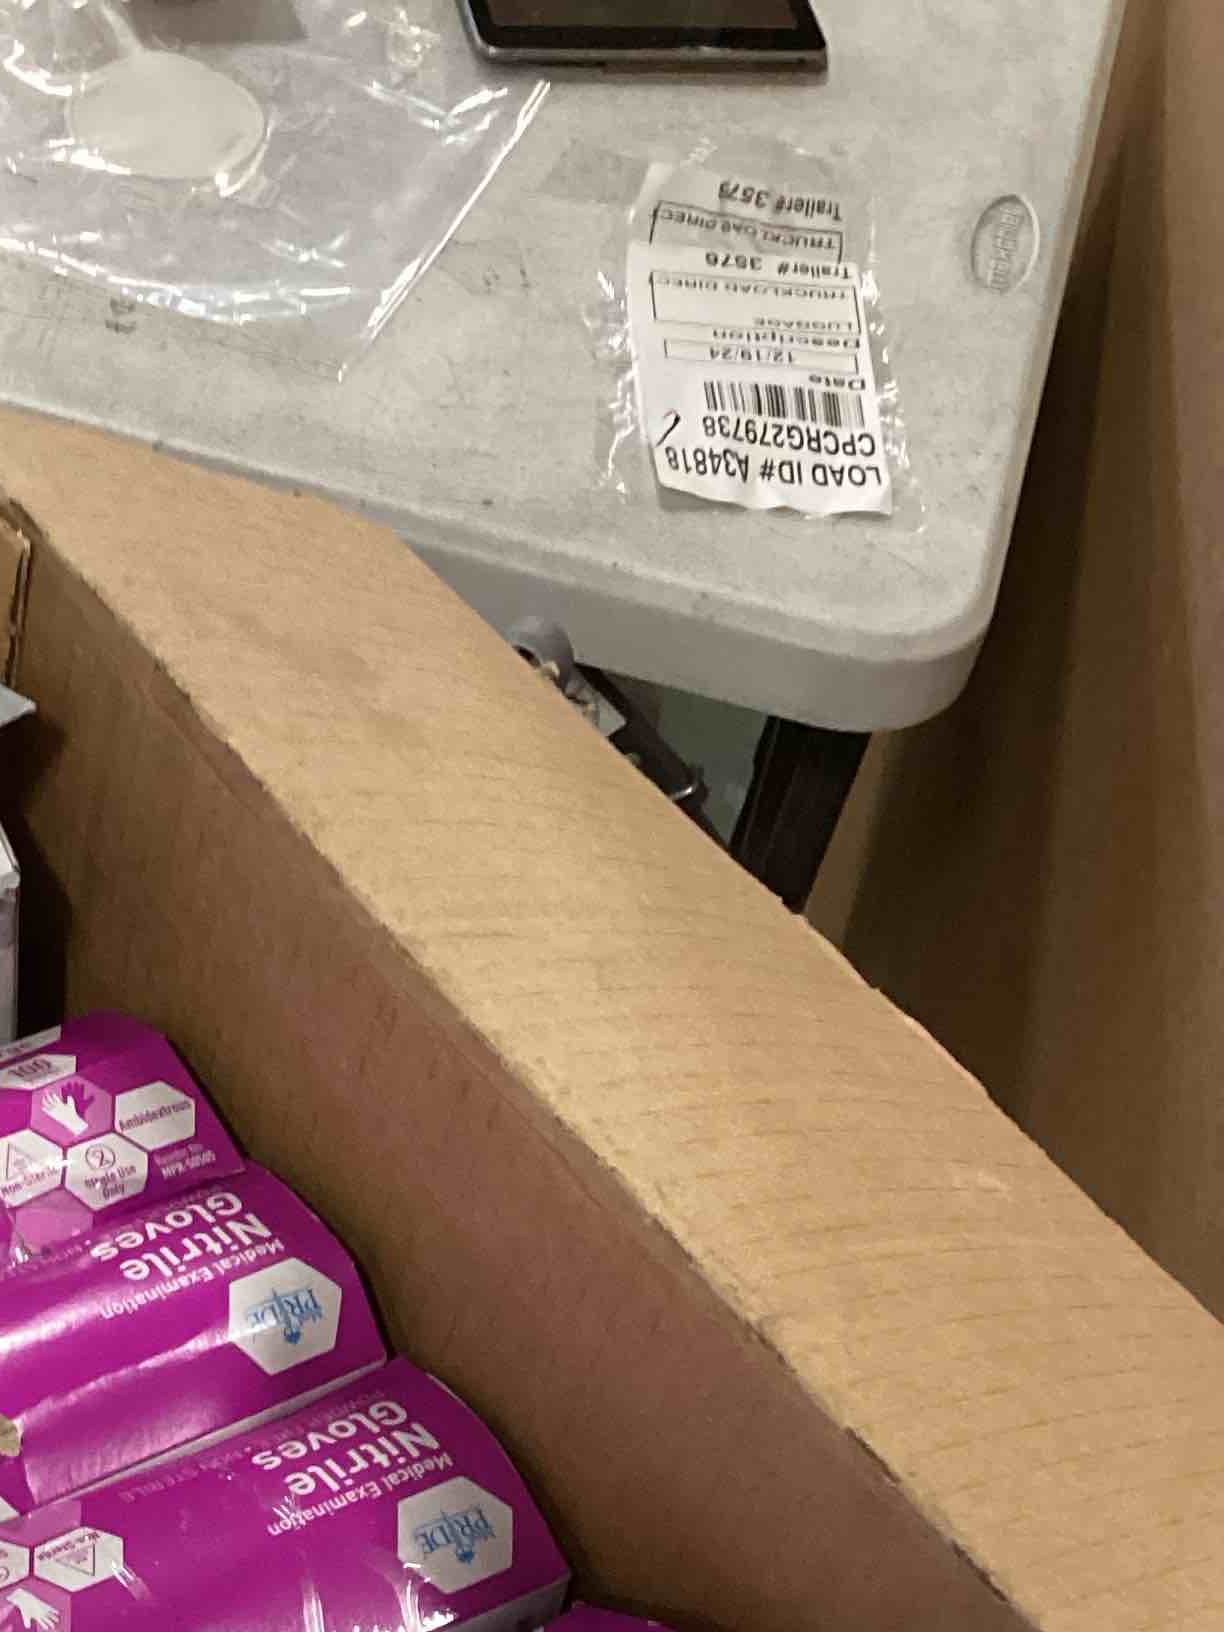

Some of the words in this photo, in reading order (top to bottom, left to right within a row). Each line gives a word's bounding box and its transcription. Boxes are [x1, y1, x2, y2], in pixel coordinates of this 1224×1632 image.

[712, 328, 861, 350] Description
[808, 375, 866, 391] Date
[703, 415, 876, 457] CPCRG279738
[760, 458, 803, 486] ID#
[811, 463, 881, 487] LOAD
[91, 1191, 243, 1262] Gloves
[119, 1213, 273, 1281] Nitrile
[219, 1237, 285, 1277] Medical
[100, 1264, 214, 1320] Examination
[251, 1399, 408, 1471] Gloves
[284, 1423, 441, 1496] Nitrile
[386, 1451, 453, 1492] Medical
[266, 1480, 383, 1536] Examination
[413, 1505, 499, 1556] PRIDE
